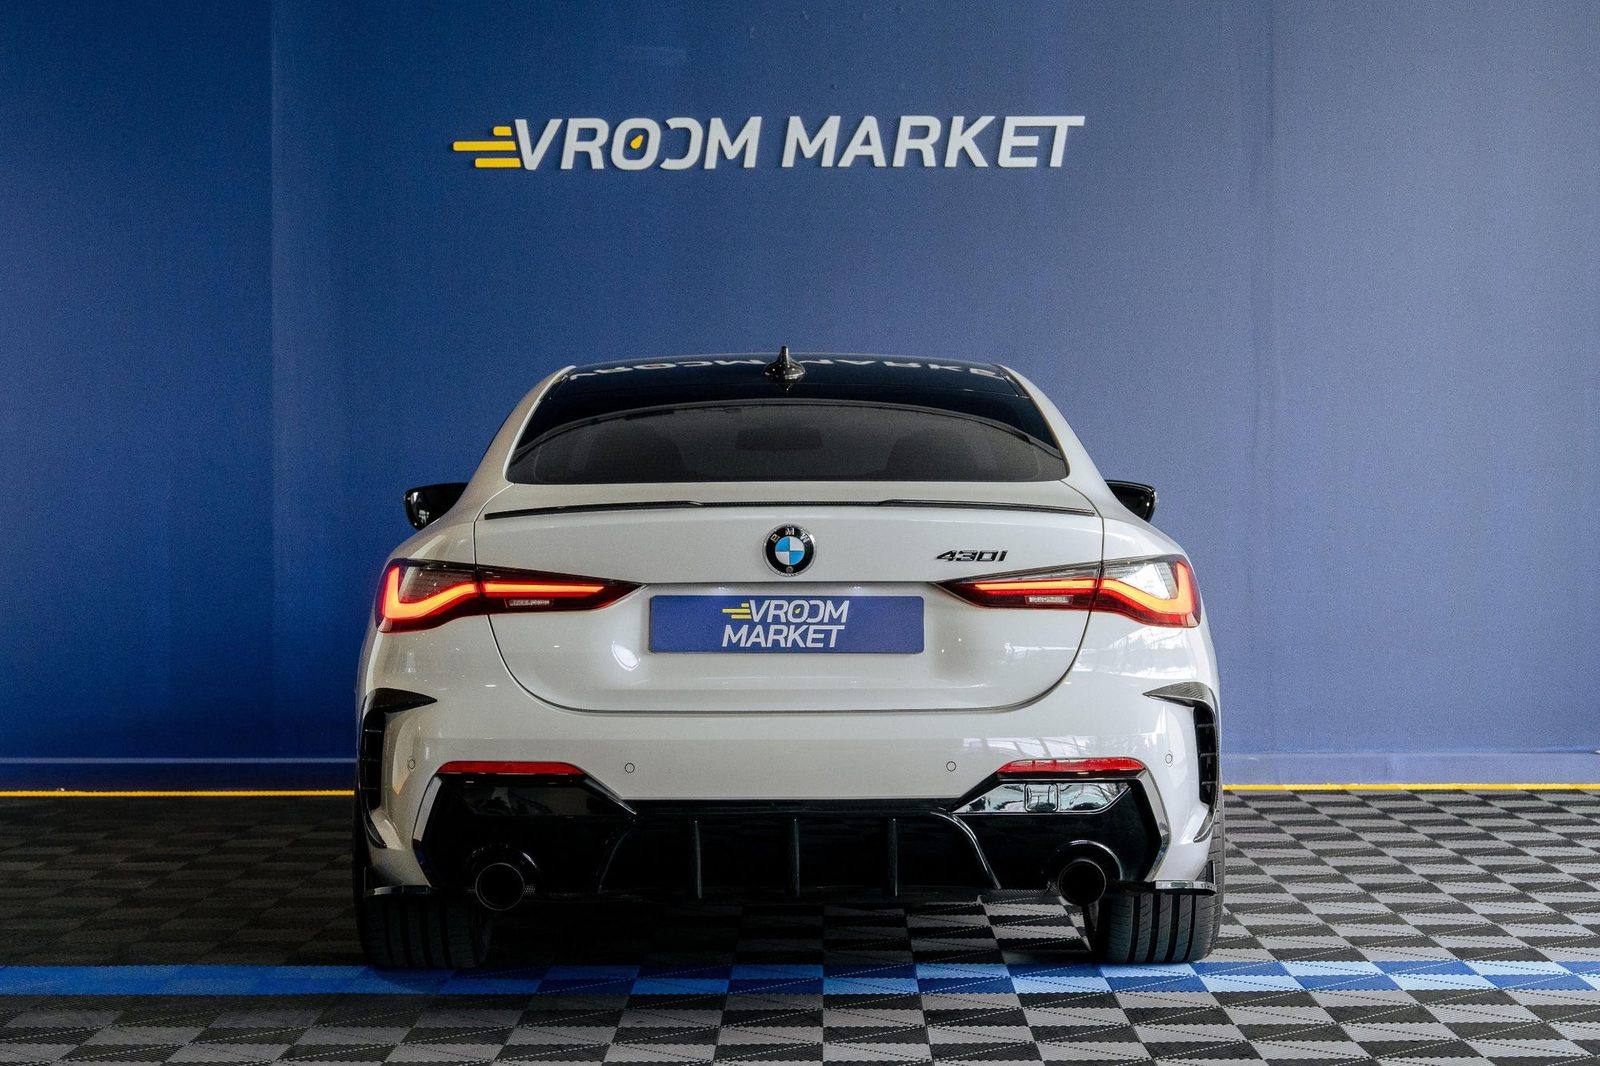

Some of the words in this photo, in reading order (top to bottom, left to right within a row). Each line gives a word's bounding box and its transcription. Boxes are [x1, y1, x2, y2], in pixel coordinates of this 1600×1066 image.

[515, 117, 763, 170] VROOM
[782, 115, 1085, 168] MARKET
[749, 600, 850, 623] VROOM
[722, 624, 846, 648] MARKET
